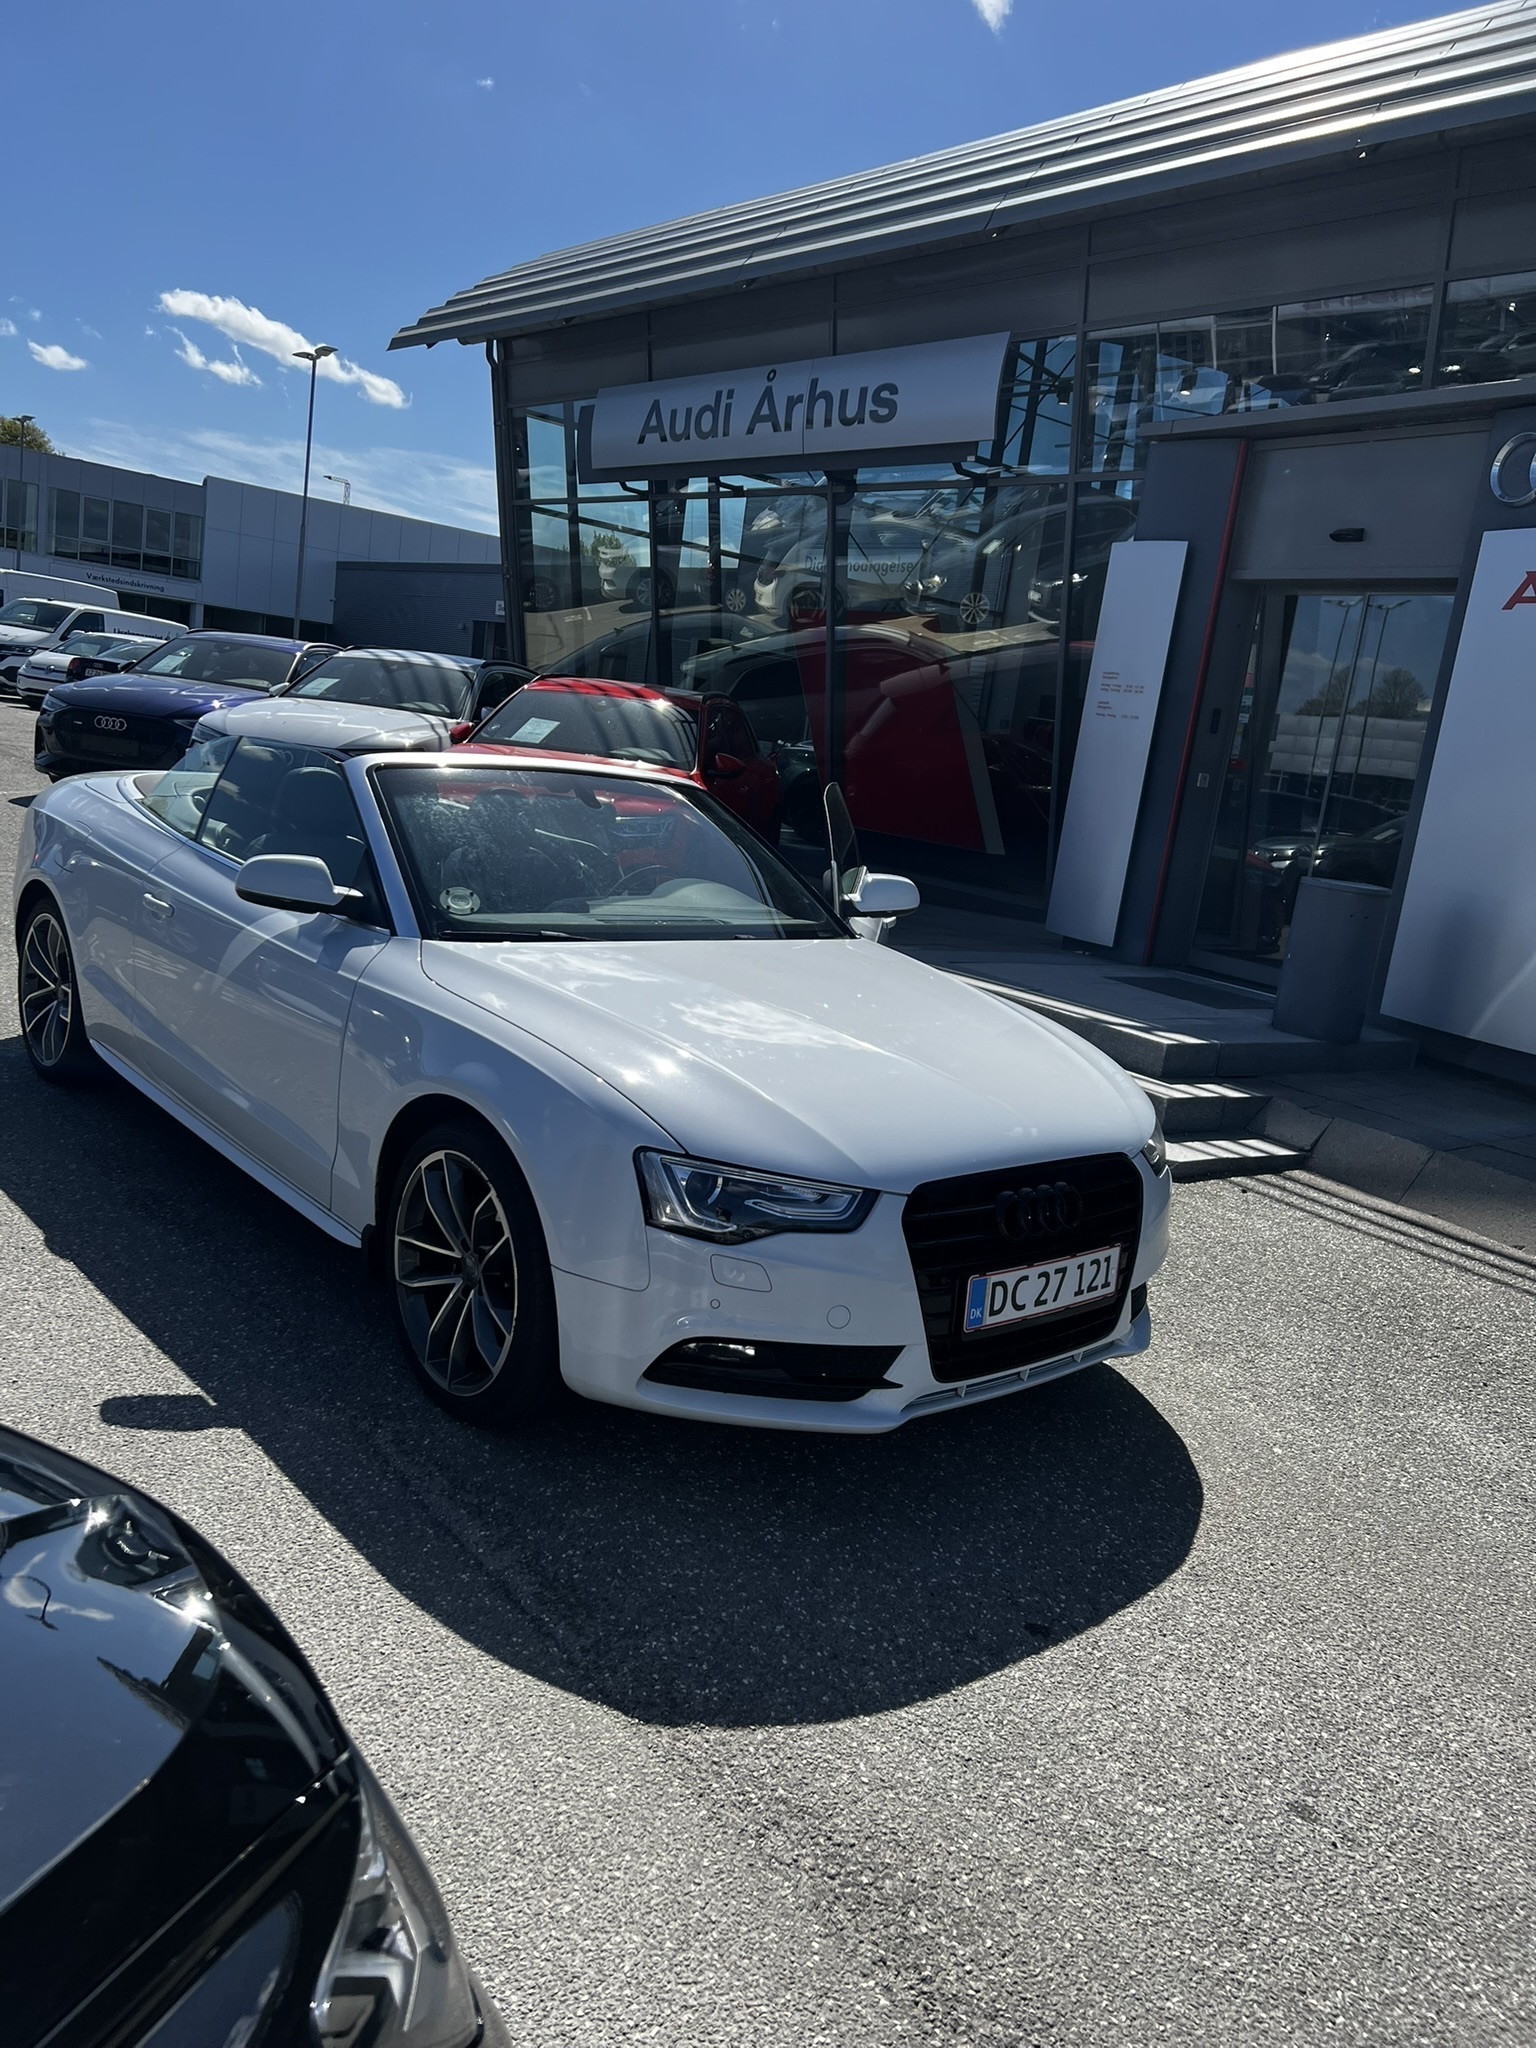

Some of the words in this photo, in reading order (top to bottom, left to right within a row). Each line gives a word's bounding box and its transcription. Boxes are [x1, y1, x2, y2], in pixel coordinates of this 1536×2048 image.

[637, 388, 735, 445] Audi
[744, 368, 899, 436] Århus
[86, 572, 165, 592] Værkstedsindskrivning
[988, 1274, 1030, 1318] DC
[1033, 1265, 1068, 1308] 27
[1073, 1254, 1112, 1298] 121
[969, 1306, 983, 1320] DK
